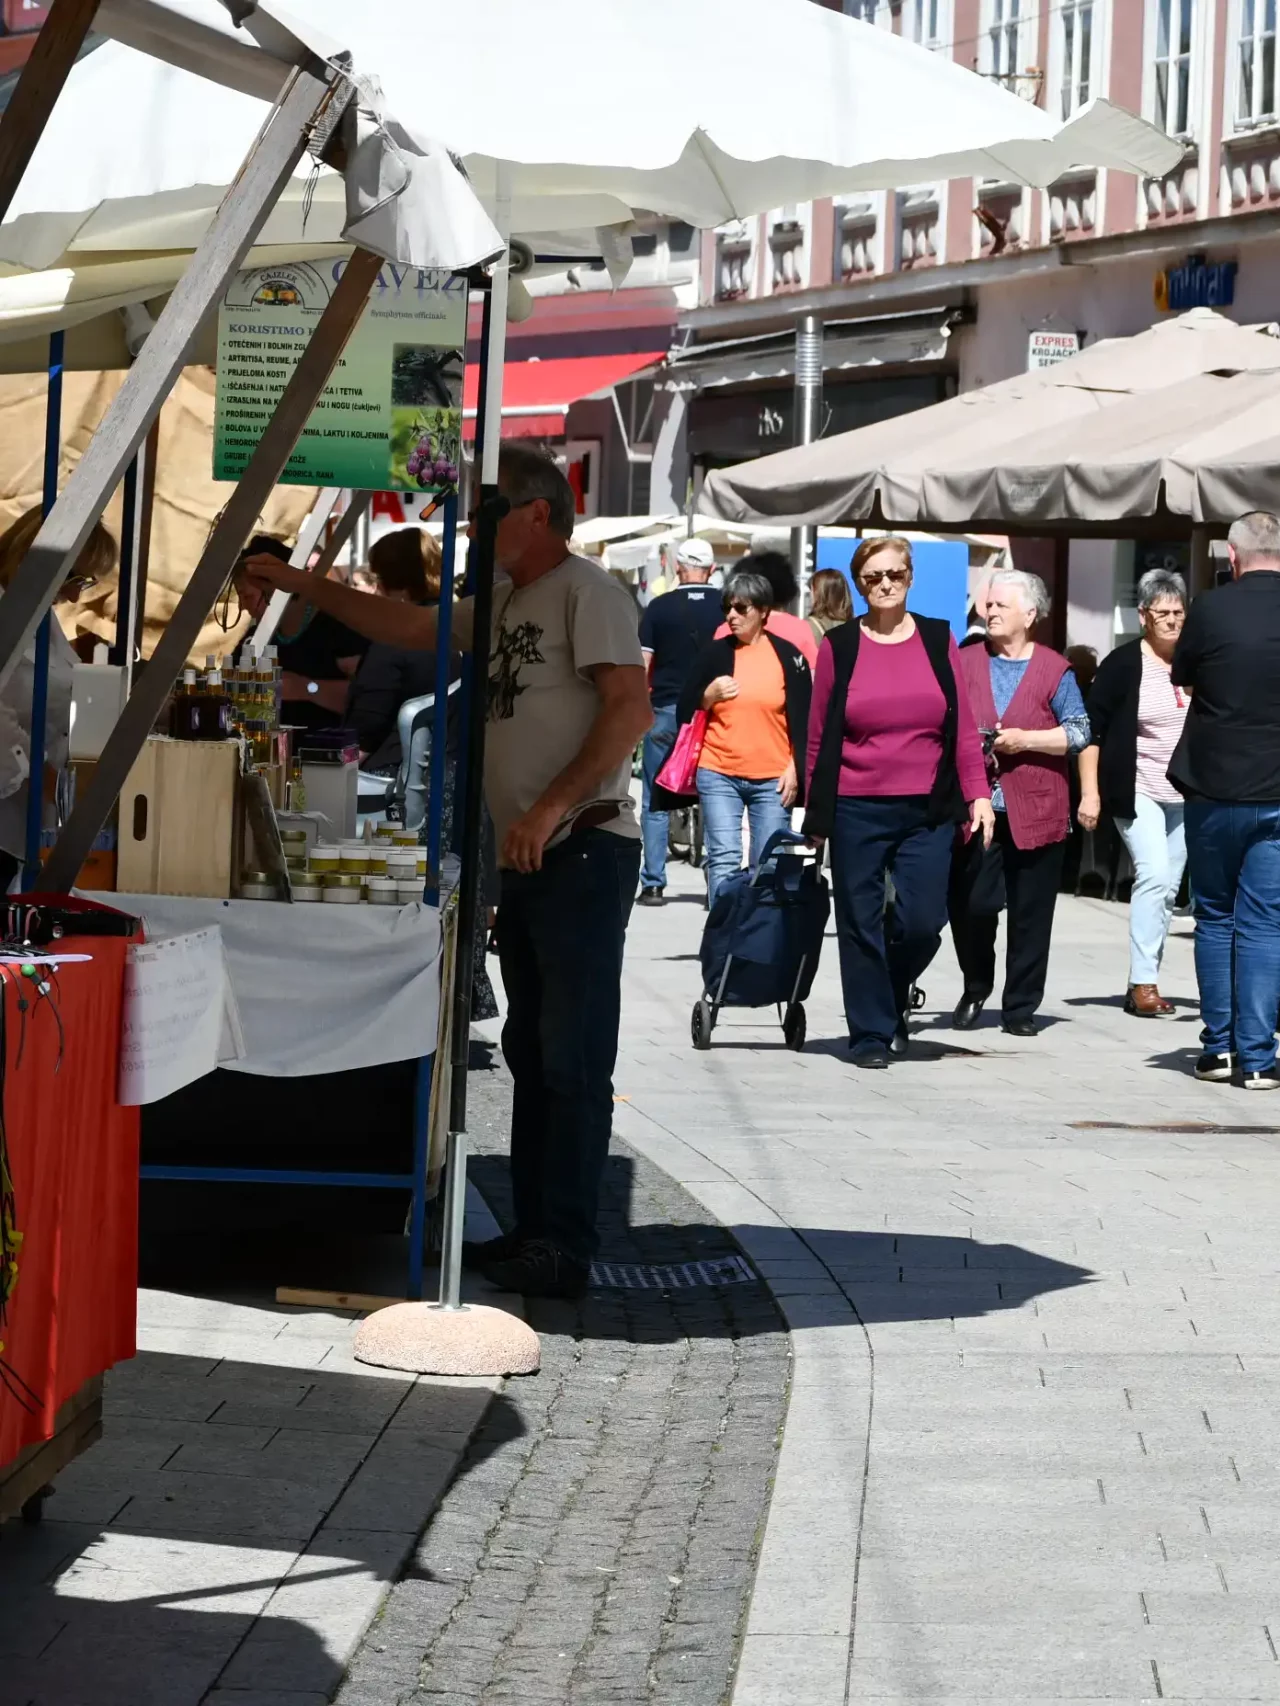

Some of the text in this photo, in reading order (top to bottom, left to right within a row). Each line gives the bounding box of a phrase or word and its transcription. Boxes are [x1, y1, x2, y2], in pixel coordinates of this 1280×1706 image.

[229, 324, 305, 336] KORISTIMO
[1035, 335, 1074, 348] EXPRES
[1032, 347, 1077, 357] KROJAČK
[266, 370, 287, 378] KOSTI
[339, 387, 363, 396] TETIVA
